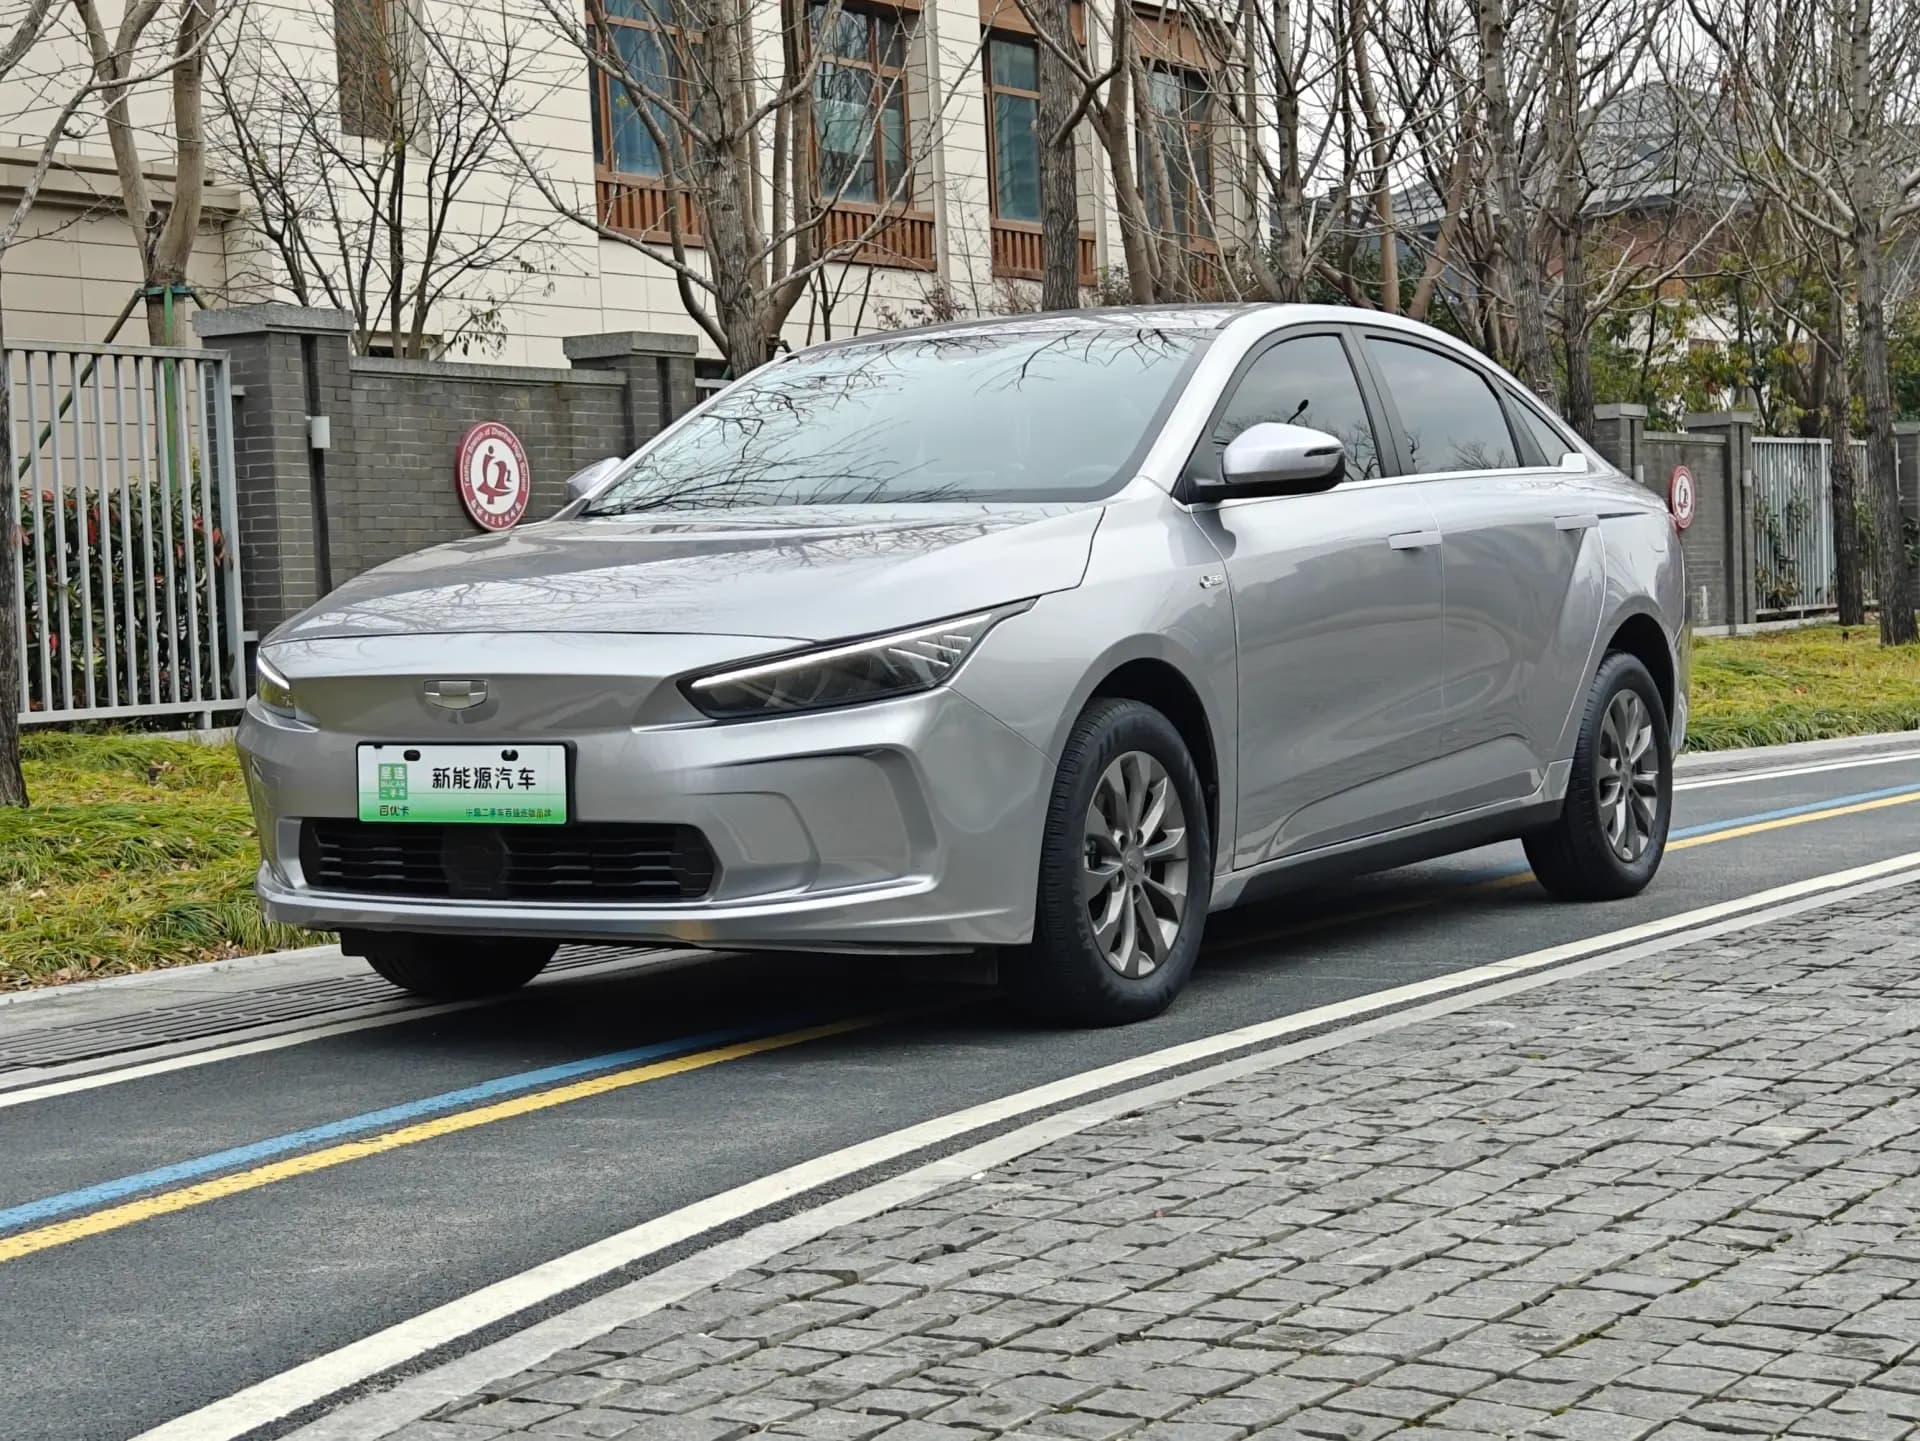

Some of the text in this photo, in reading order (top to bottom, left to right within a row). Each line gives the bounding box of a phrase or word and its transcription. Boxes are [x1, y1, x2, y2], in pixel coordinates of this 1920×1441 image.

[432, 767, 536, 790] 新能源汽车
